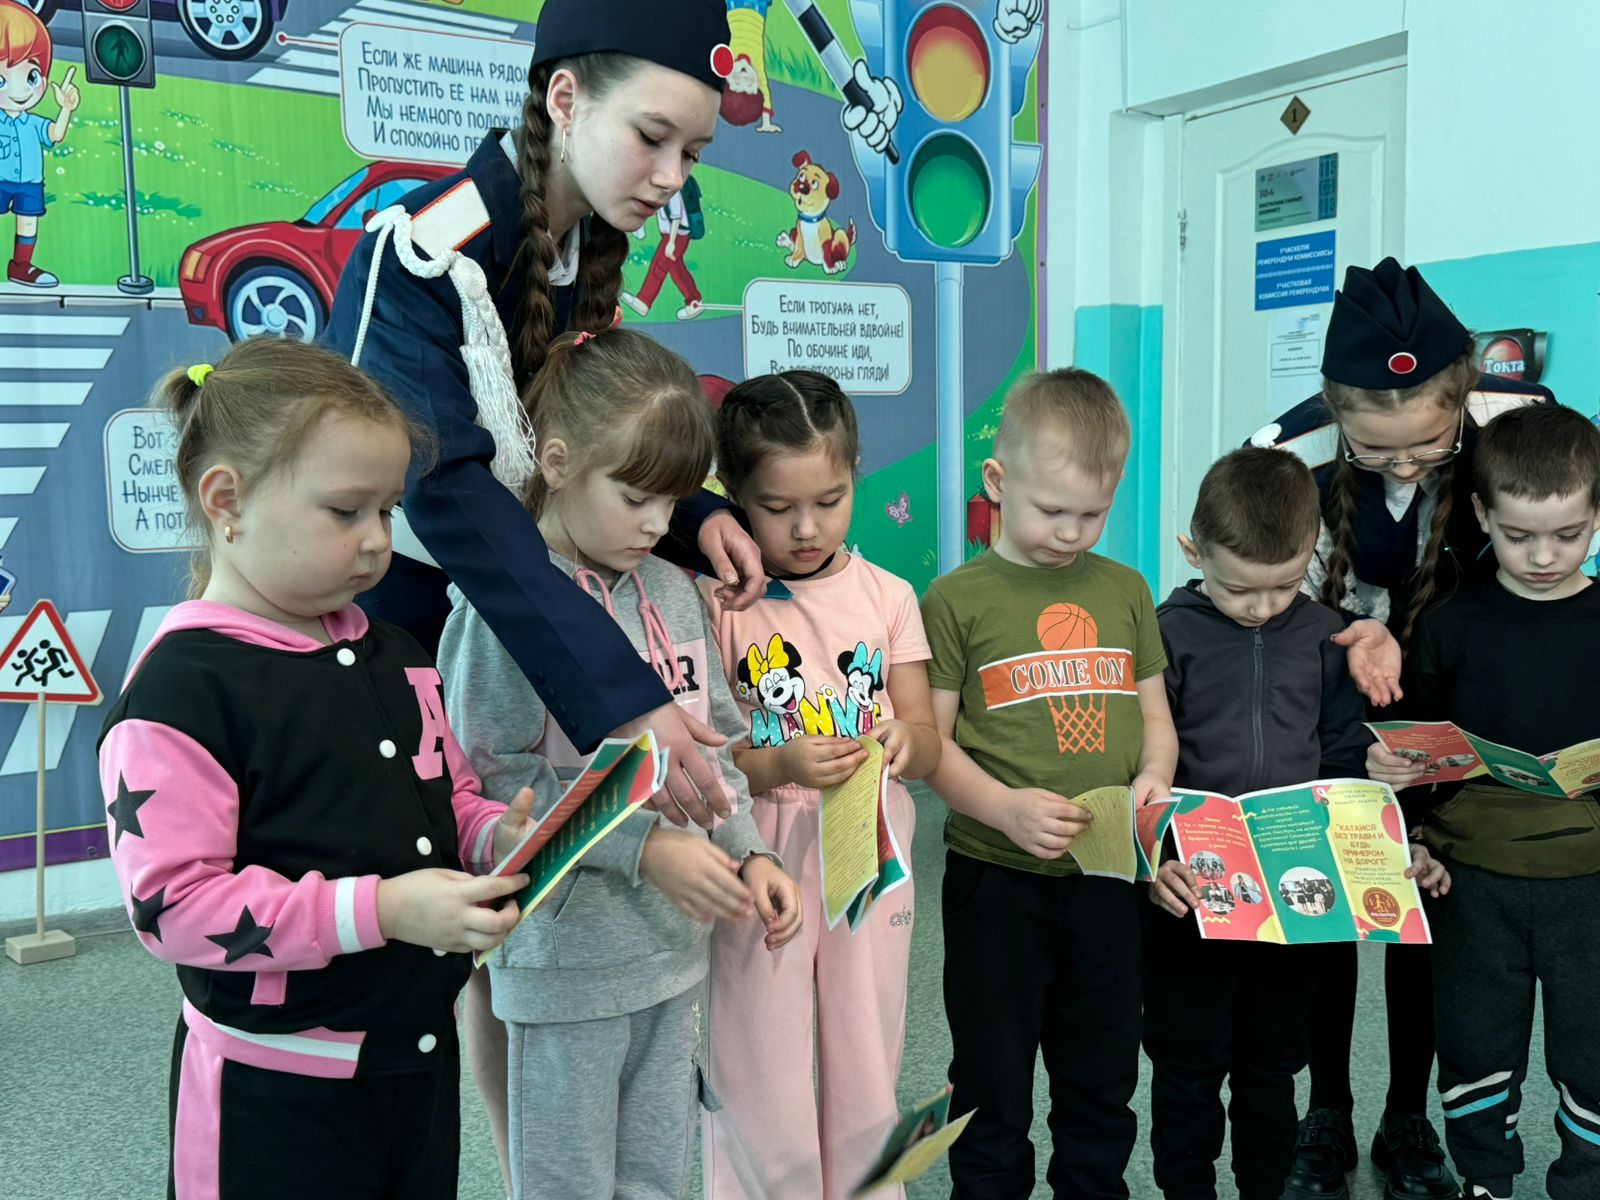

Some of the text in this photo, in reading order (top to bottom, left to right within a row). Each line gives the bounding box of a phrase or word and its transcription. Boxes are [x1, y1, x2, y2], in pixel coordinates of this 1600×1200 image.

[362, 41, 398, 68] ЕСЛИ
[403, 53, 423, 71] ЖЕ
[429, 56, 484, 78] МАШИНА
[358, 67, 444, 100] ПРОПУСТИТЬ
[471, 86, 500, 105] НАМ
[506, 90, 529, 108] НА
[367, 95, 393, 120] МЫ
[400, 105, 462, 127] НЕМНОГО
[1290, 108, 1299, 123] 1
[373, 121, 485, 153] И СПОКОЙНО ПЕ
[780, 295, 879, 320] ЕСЛИ ТРОТУАРА НЕТ,
[752, 315, 904, 339] БУДЬ ВНИМАТЕЛЬНЕЙ ВДВОЙНЕ!
[787, 338, 872, 362] ПО ОБОЧИНЕ ИДИ,
[813, 365, 854, 380] ТОРОНЫ
[857, 363, 890, 381] ГЛЯДИ!
[133, 425, 163, 449] ВОТ
[128, 453, 176, 475] СМЕЛ
[122, 479, 178, 504] НЫНЧЕ
[135, 506, 149, 531] А
[1010, 656, 1126, 695] COME ON
